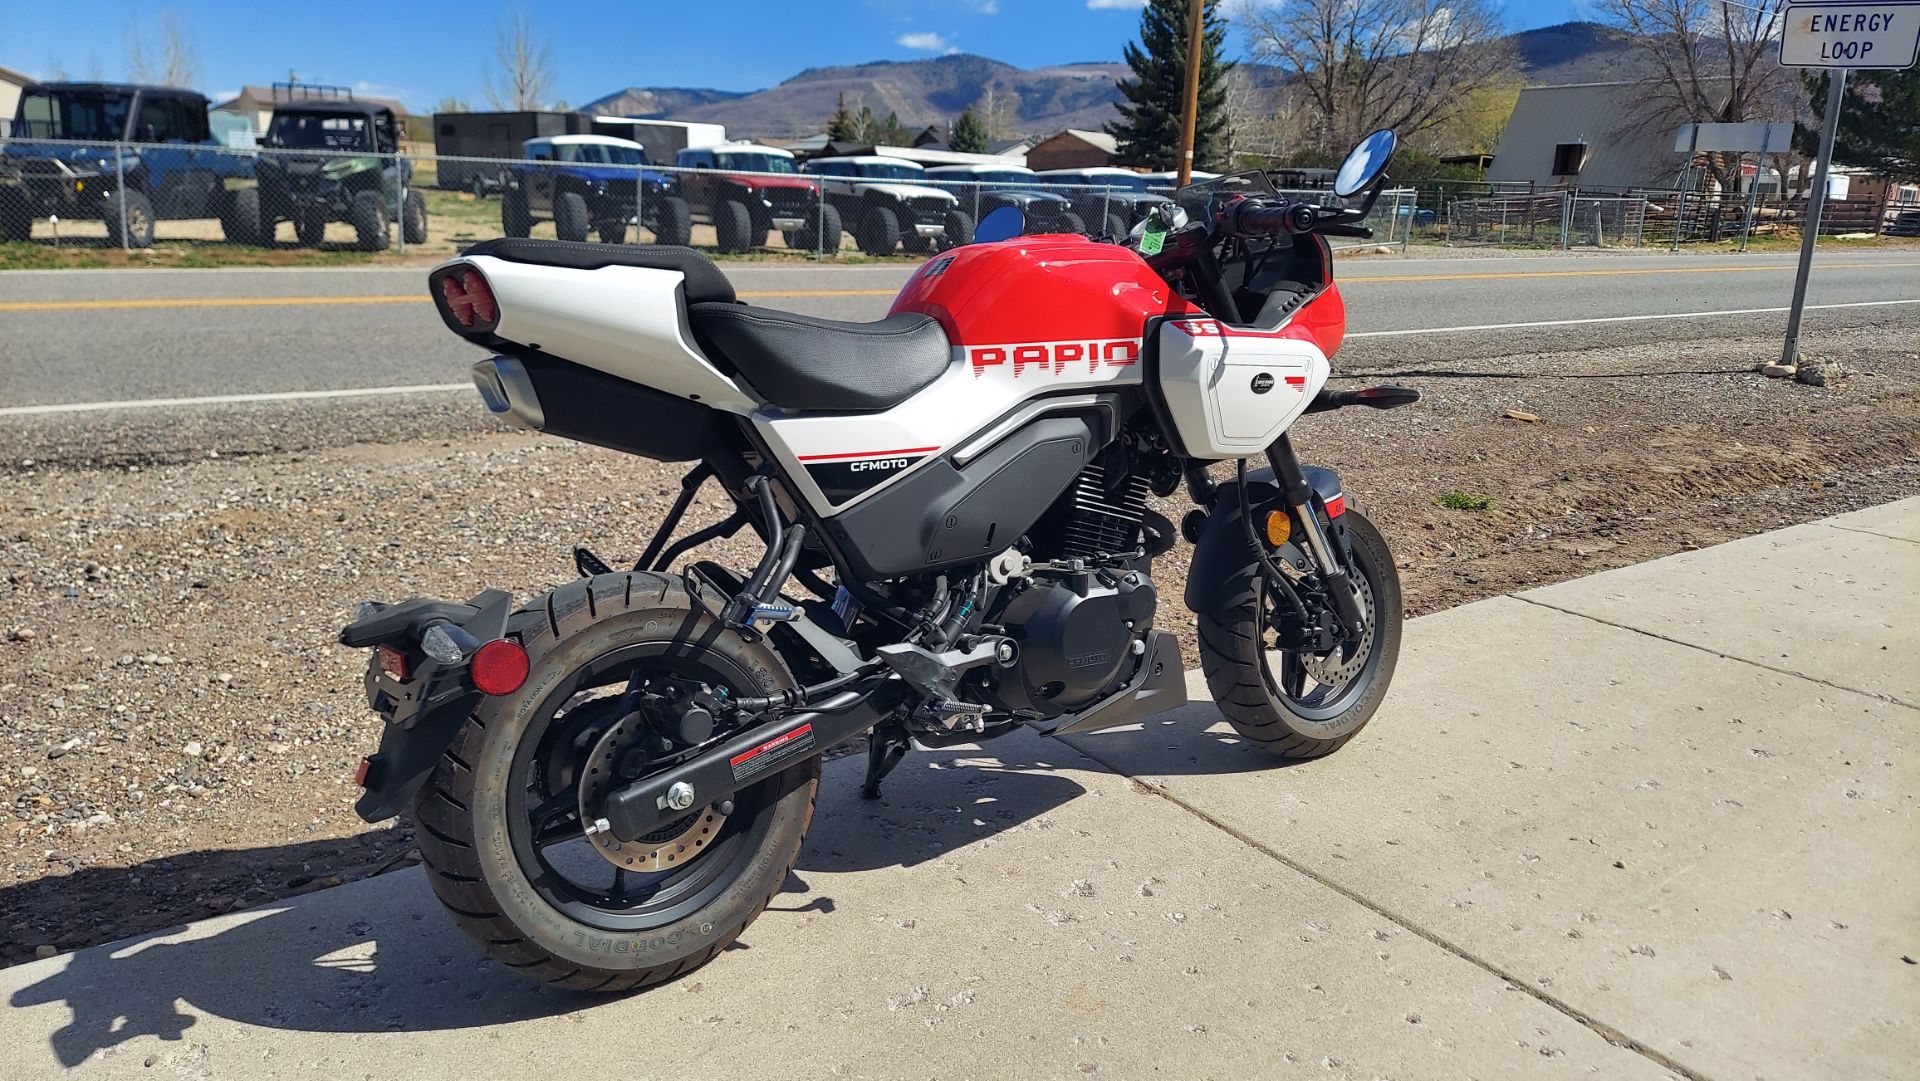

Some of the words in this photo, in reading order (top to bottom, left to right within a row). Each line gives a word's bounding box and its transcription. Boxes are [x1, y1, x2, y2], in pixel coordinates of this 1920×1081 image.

[1810, 13, 1895, 33] ENERGY
[1820, 41, 1873, 60] LOOP
[850, 458, 908, 472] CFMOTO
